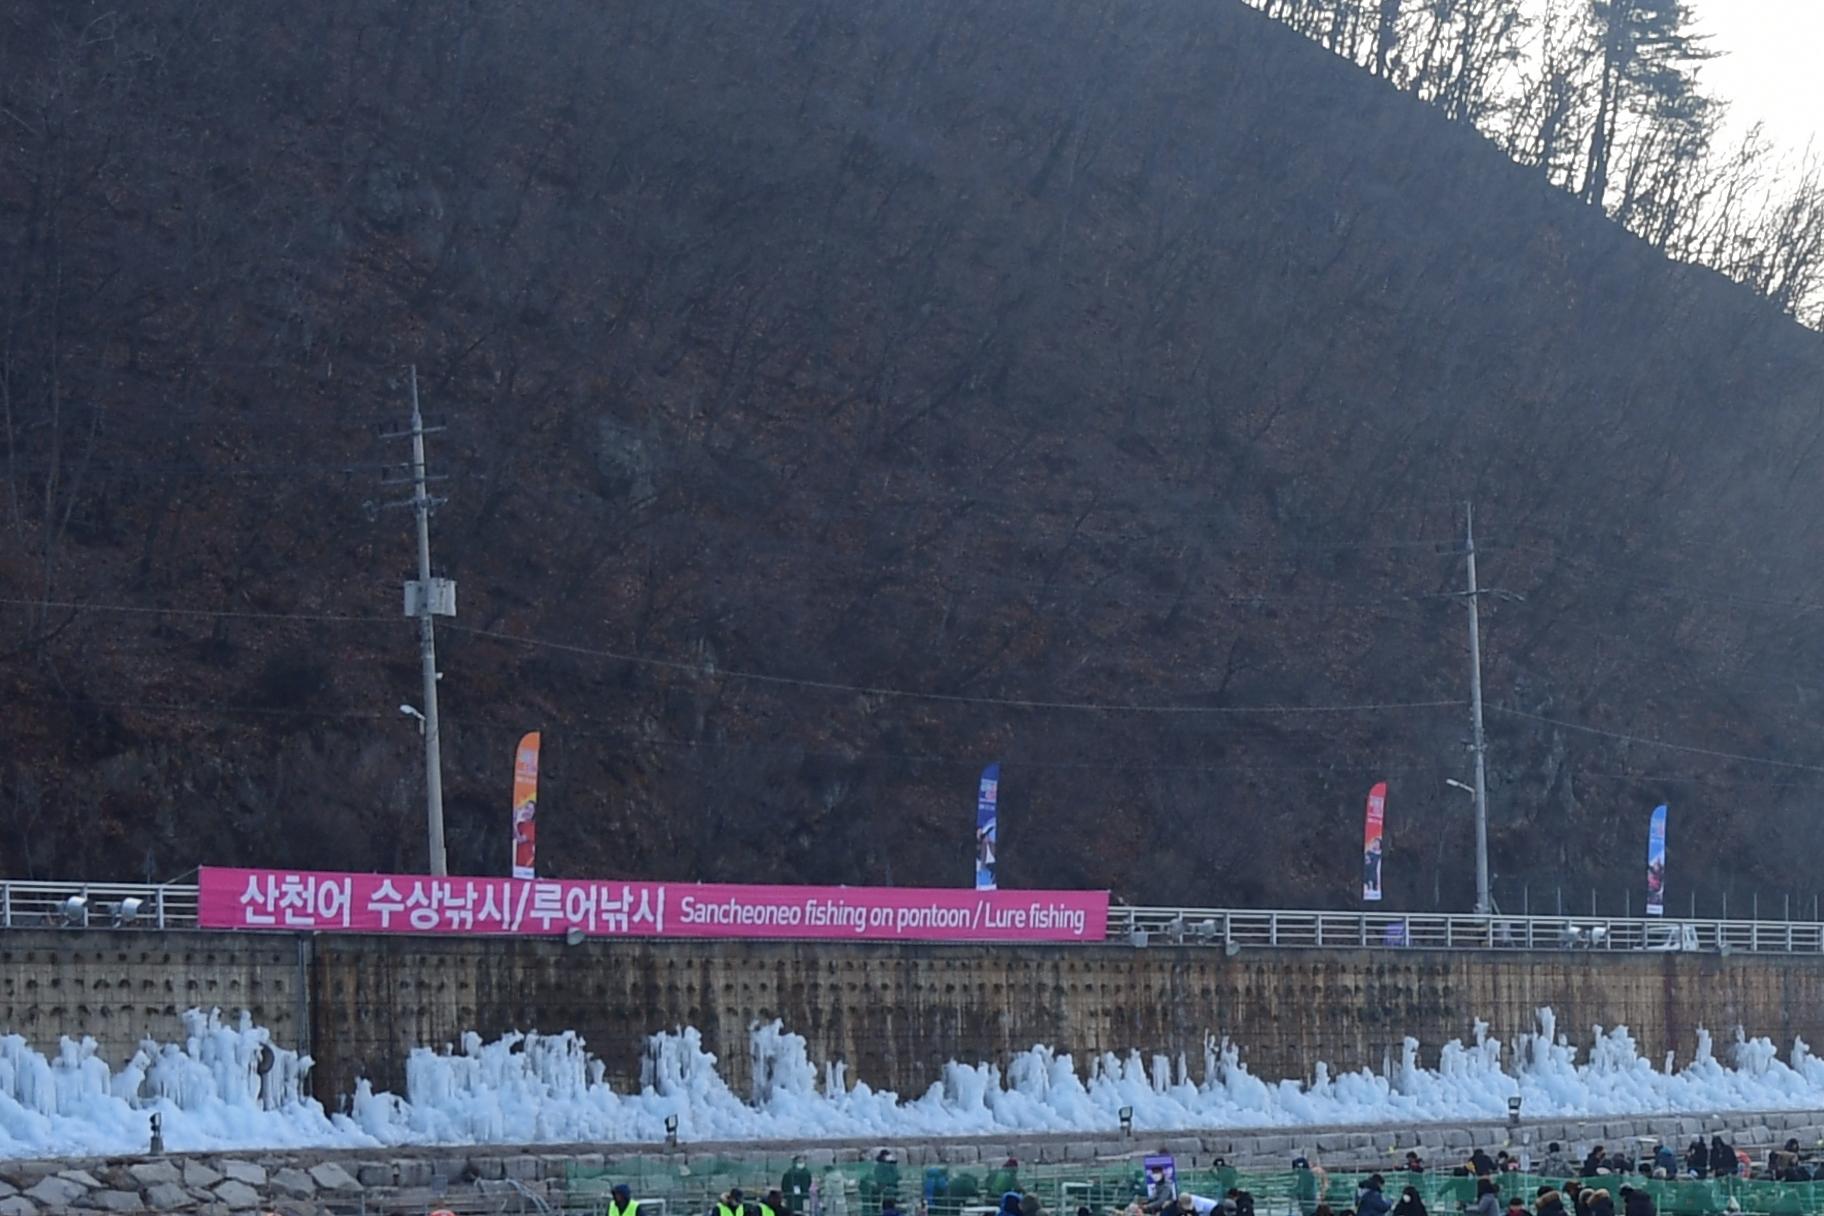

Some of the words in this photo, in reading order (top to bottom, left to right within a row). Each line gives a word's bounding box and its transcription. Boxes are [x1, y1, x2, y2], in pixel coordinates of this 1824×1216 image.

[239, 874, 352, 928] 산천어
[367, 877, 666, 932] 수상낚시/루어낚시
[680, 896, 801, 925] Sancheoneo
[804, 899, 867, 933] fishing
[870, 906, 893, 926] on
[1029, 902, 1085, 935] fishing
